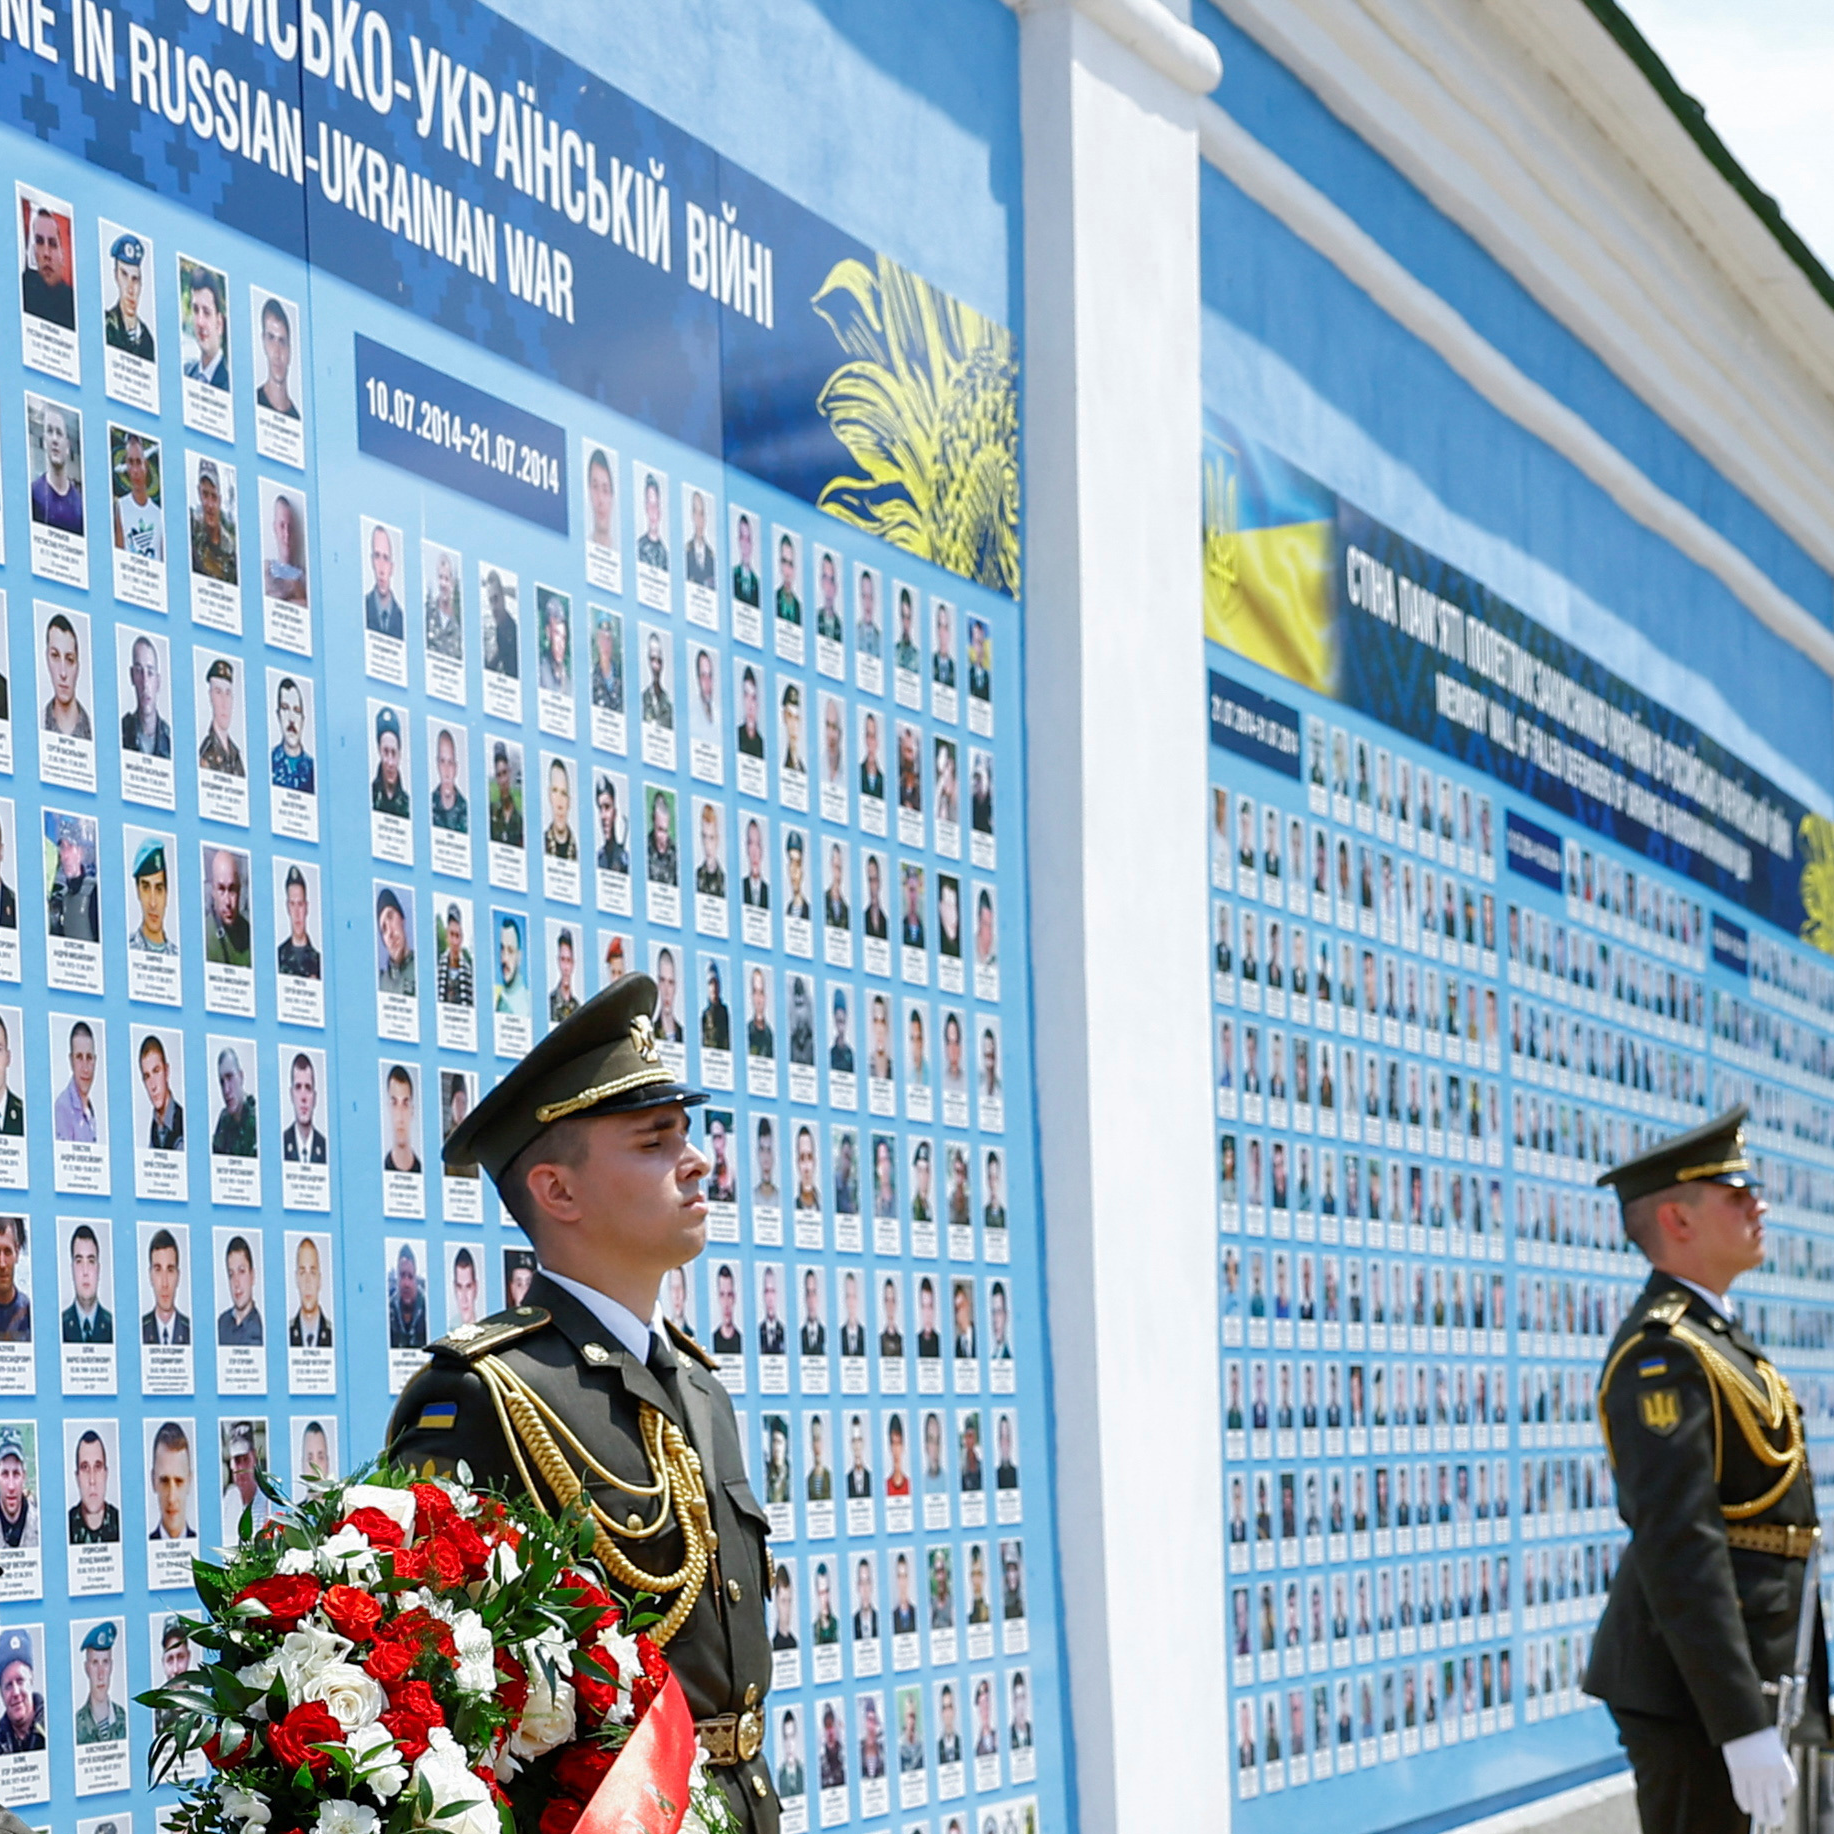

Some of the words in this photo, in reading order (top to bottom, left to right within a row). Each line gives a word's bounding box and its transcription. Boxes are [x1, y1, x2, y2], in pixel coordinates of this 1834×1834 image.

[72, 0, 116, 93] IN
[129, 22, 497, 285] RUSSIAN-UKRAINIAN
[503, 222, 575, 326] WAR
[685, 200, 774, 331] ВІЙНІ
